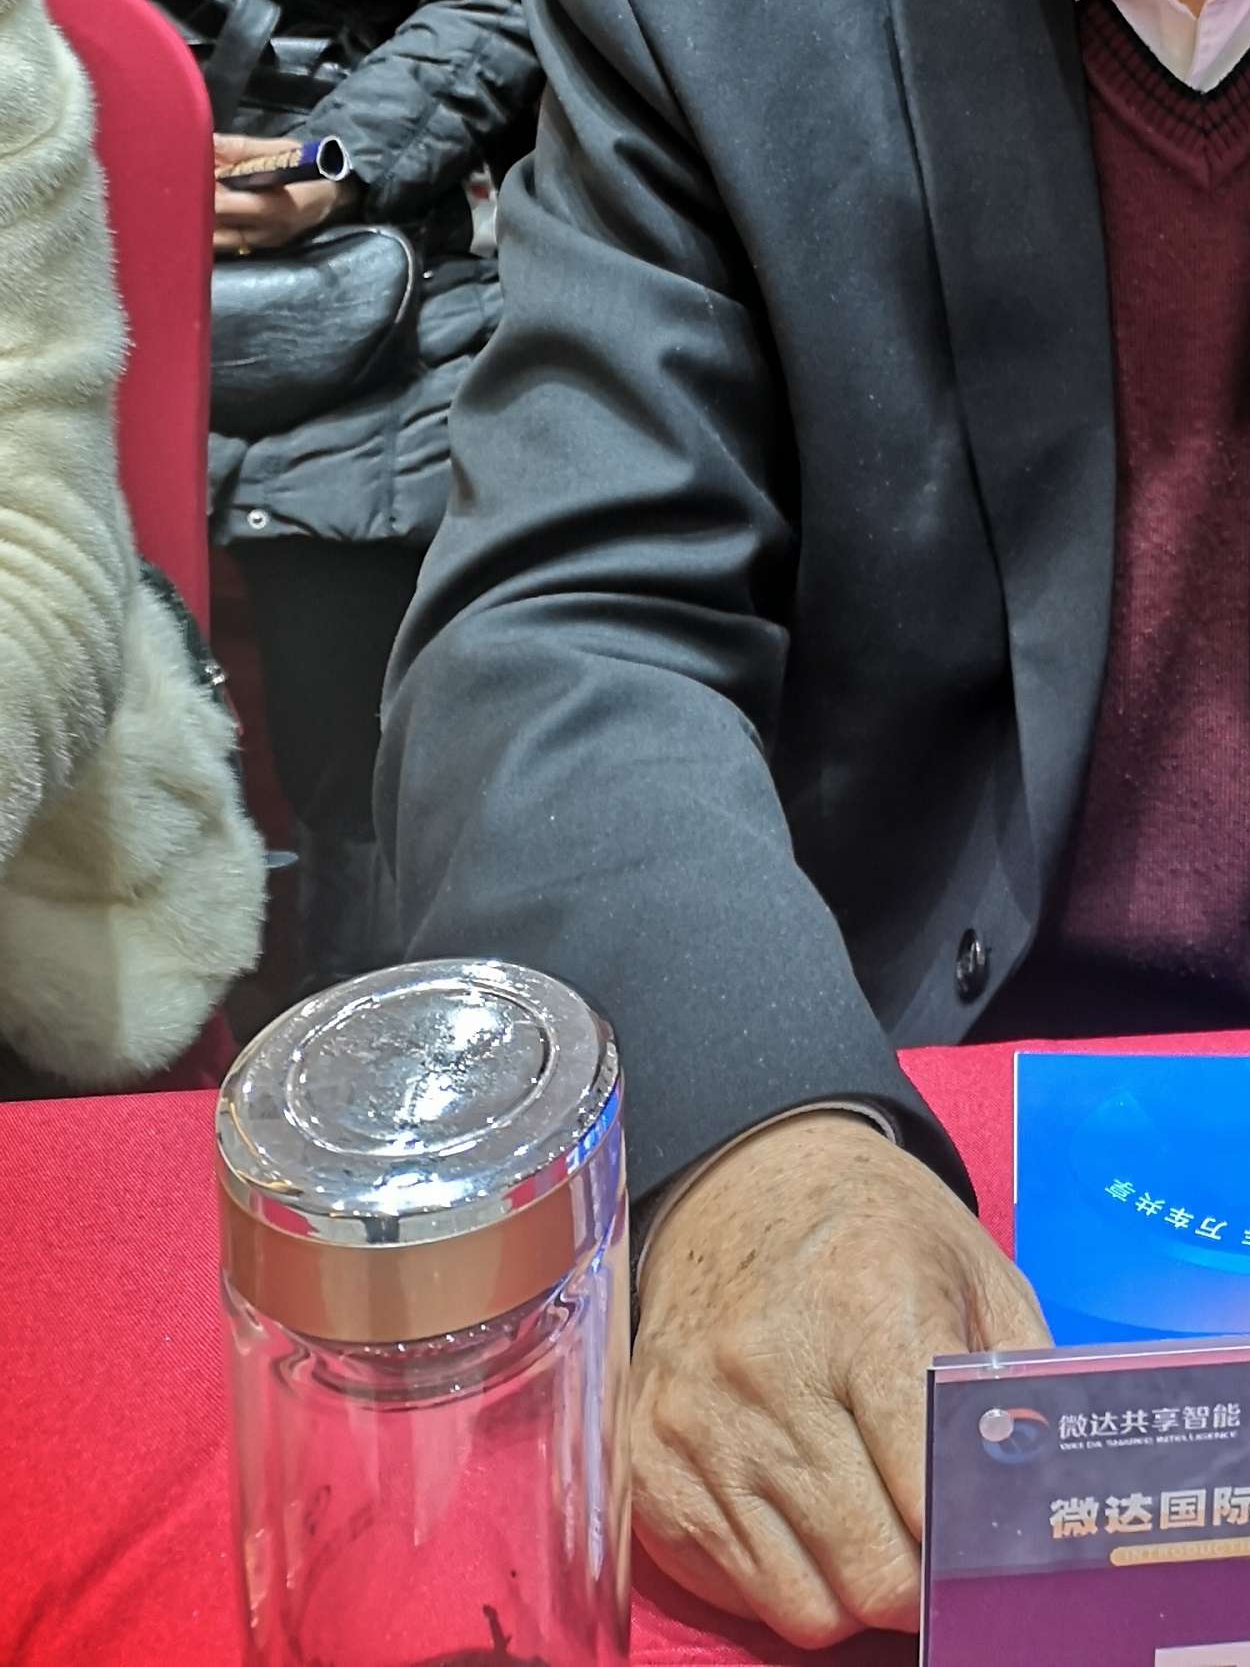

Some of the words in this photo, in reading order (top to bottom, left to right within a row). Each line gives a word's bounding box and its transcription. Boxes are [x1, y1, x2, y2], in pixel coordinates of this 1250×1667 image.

[1104, 1178, 1229, 1241] 万车共享
[1058, 1403, 1242, 1440] 微达共享智能
